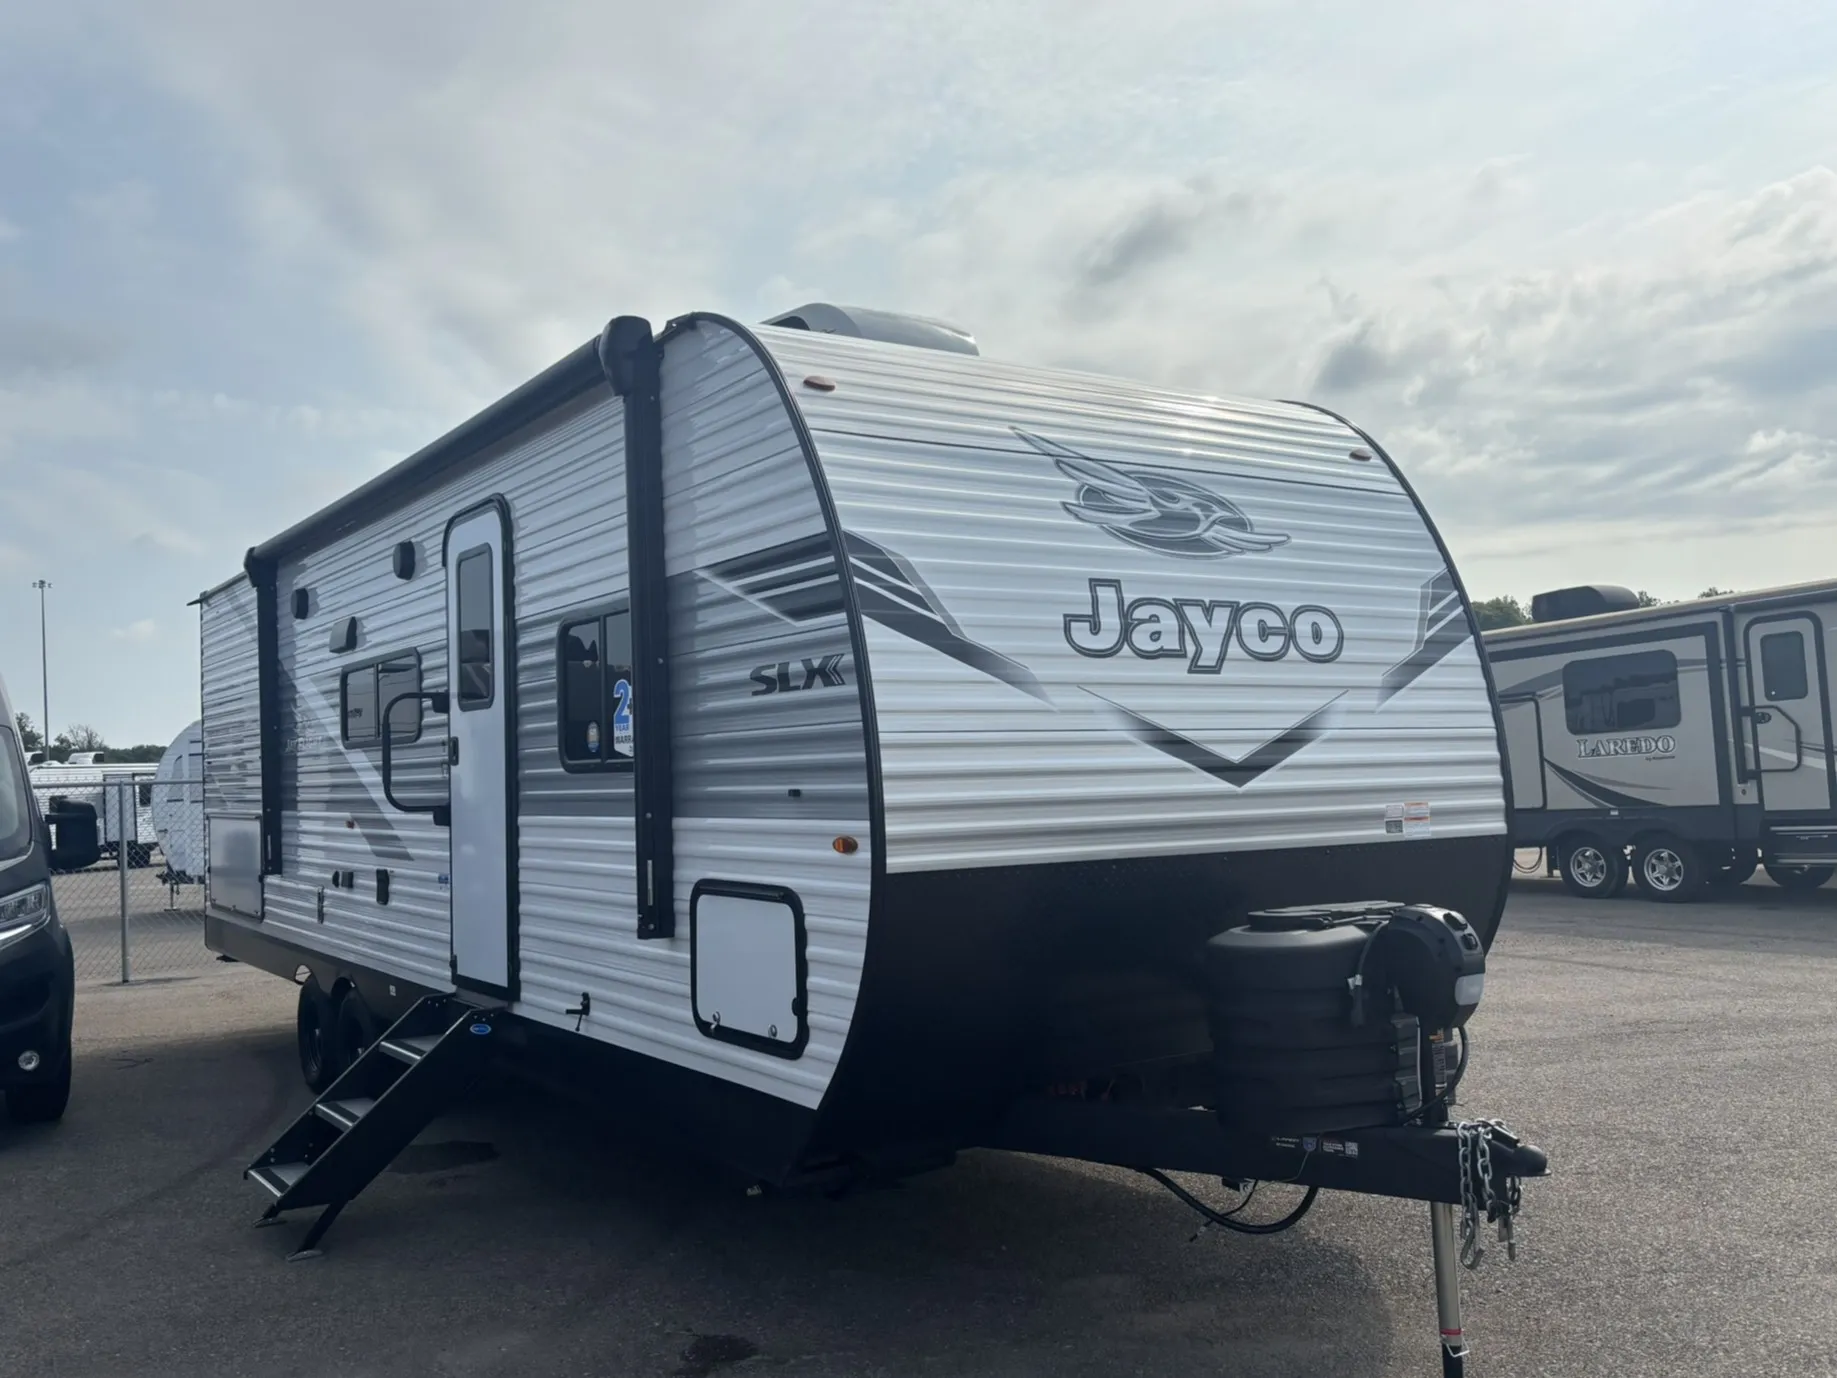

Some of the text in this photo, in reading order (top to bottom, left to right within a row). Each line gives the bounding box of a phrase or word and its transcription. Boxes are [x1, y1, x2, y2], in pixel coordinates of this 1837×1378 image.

[1063, 578, 1344, 674] Jayco
[749, 653, 846, 696] SLX
[1576, 735, 1676, 758] LAREDO
